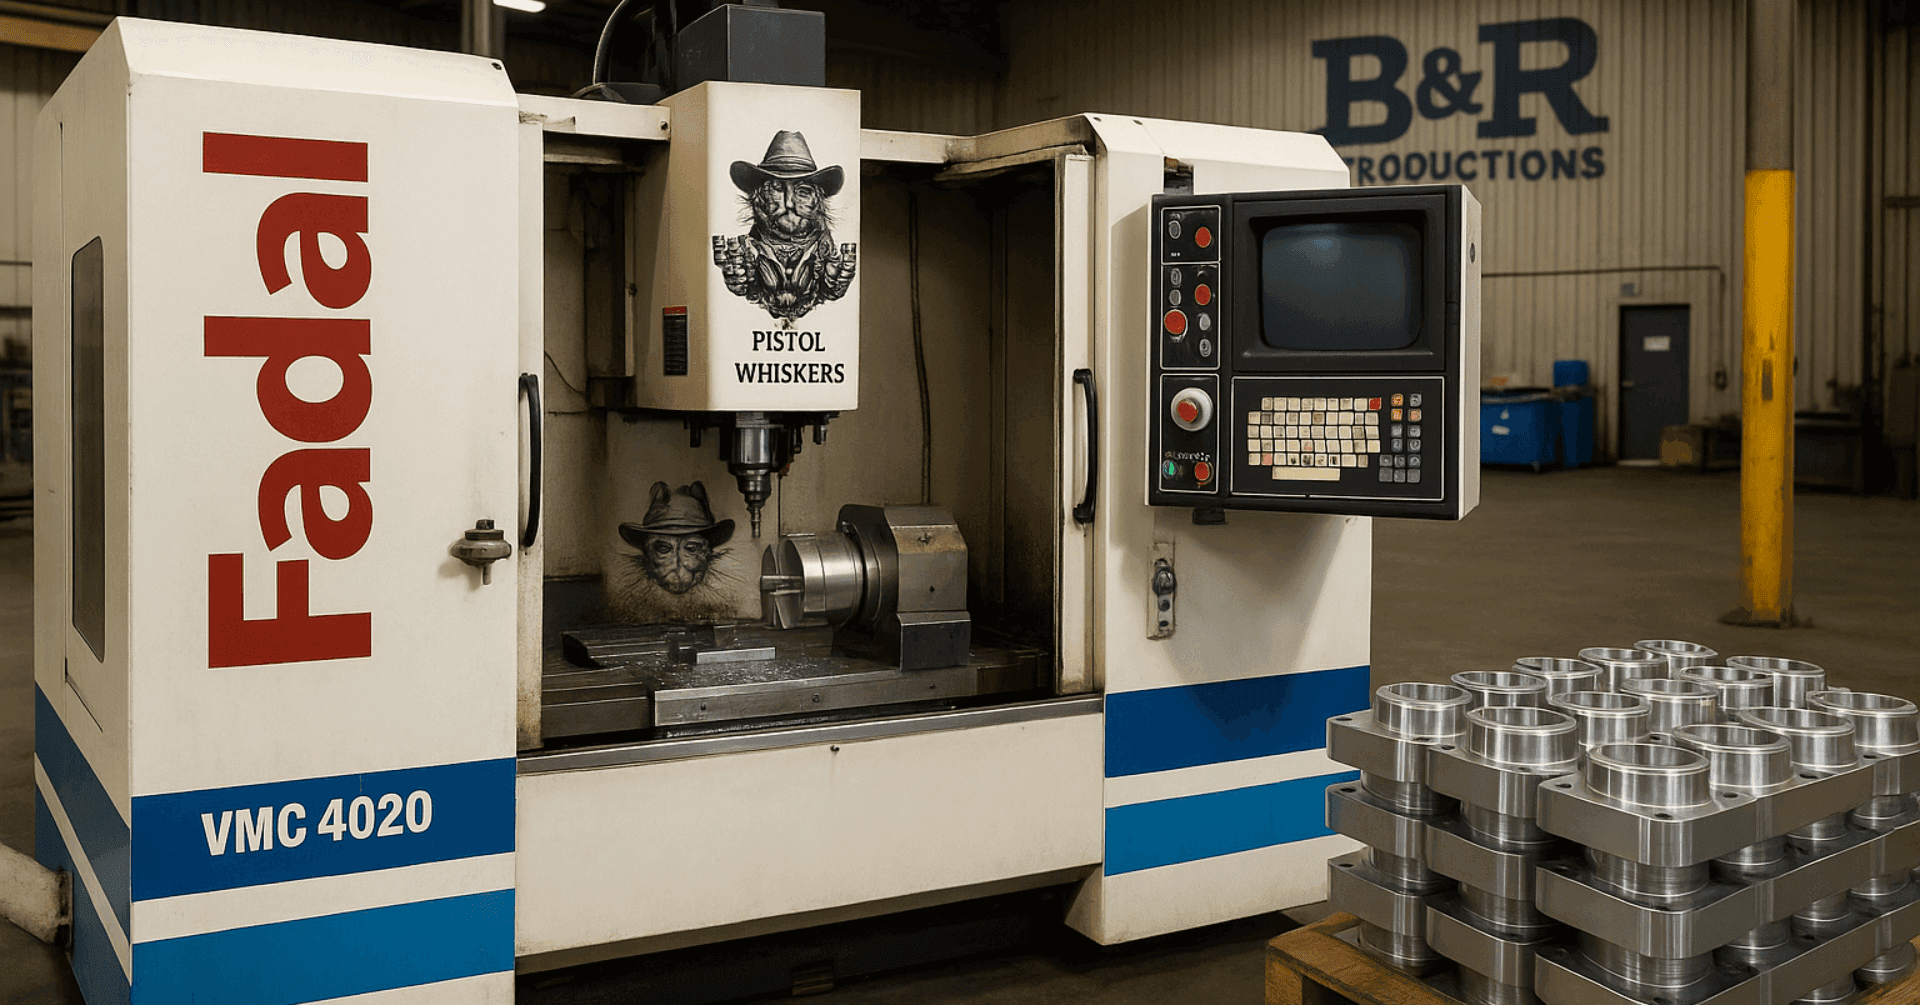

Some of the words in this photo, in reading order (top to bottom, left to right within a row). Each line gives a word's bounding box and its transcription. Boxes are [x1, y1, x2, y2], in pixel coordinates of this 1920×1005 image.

[1309, 17, 1609, 148] B&R
[1342, 147, 1605, 185] RODUCTIONS
[752, 331, 826, 352] PISTOL
[735, 362, 845, 384] WHISKERS
[203, 131, 372, 669] Fadal
[201, 802, 307, 856] VMC
[317, 790, 433, 841] 4020
